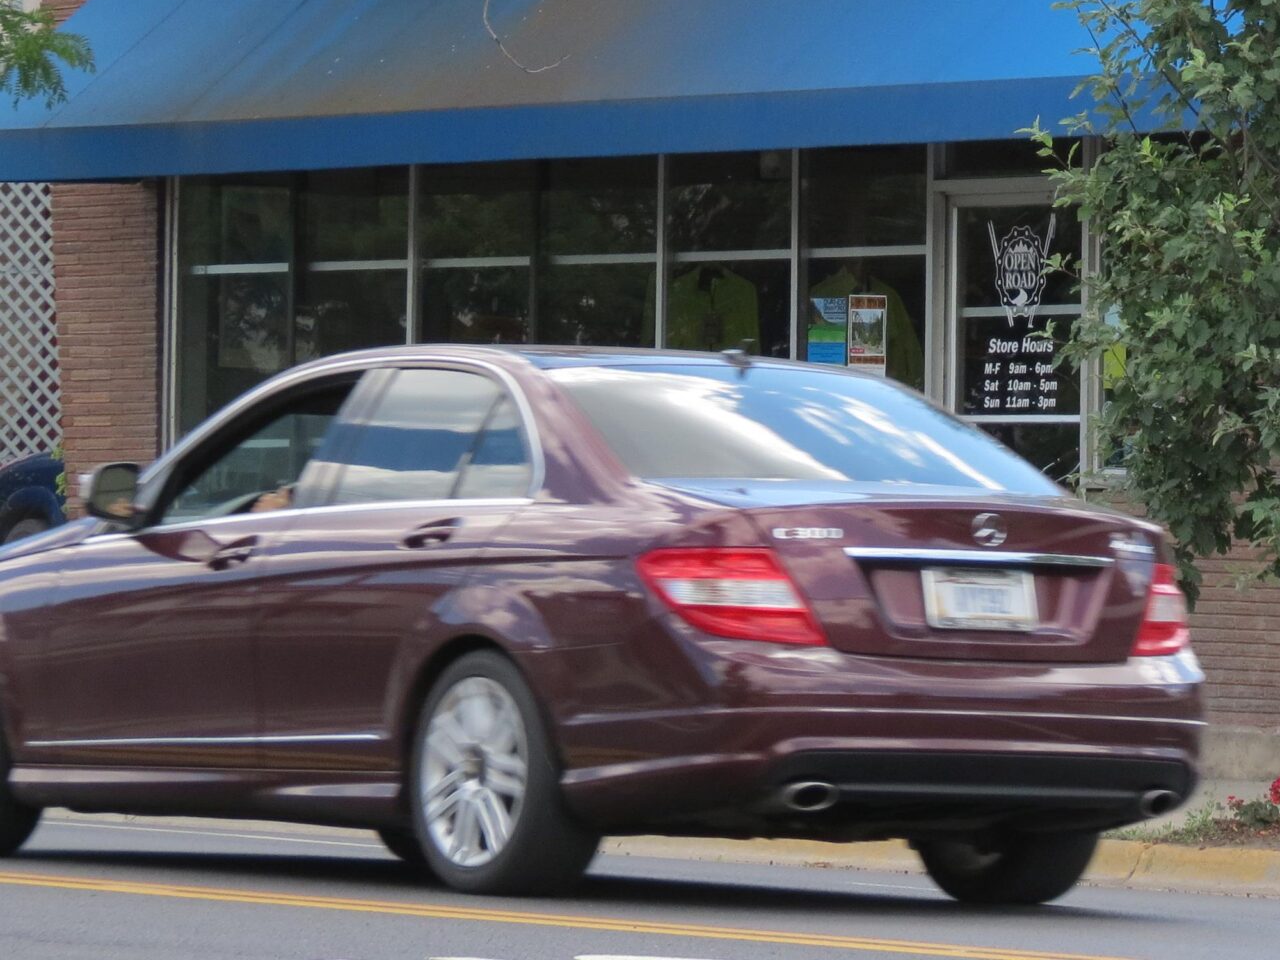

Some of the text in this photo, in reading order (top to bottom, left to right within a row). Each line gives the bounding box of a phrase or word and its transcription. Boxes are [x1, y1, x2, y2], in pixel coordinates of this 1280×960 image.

[1004, 252, 1036, 270] OPEN
[1005, 271, 1036, 289] ROAD
[988, 337, 1054, 353] Store Hours
[984, 362, 1001, 375] M-F
[1008, 362, 1027, 375] 9am
[1035, 361, 1054, 376] 6pm
[984, 379, 999, 392] Sat
[1007, 379, 1031, 392] 10am
[1039, 378, 1058, 393] 5pm
[983, 396, 1000, 408] Sun
[1005, 396, 1030, 408] 11am
[1037, 396, 1056, 410] 3pm
